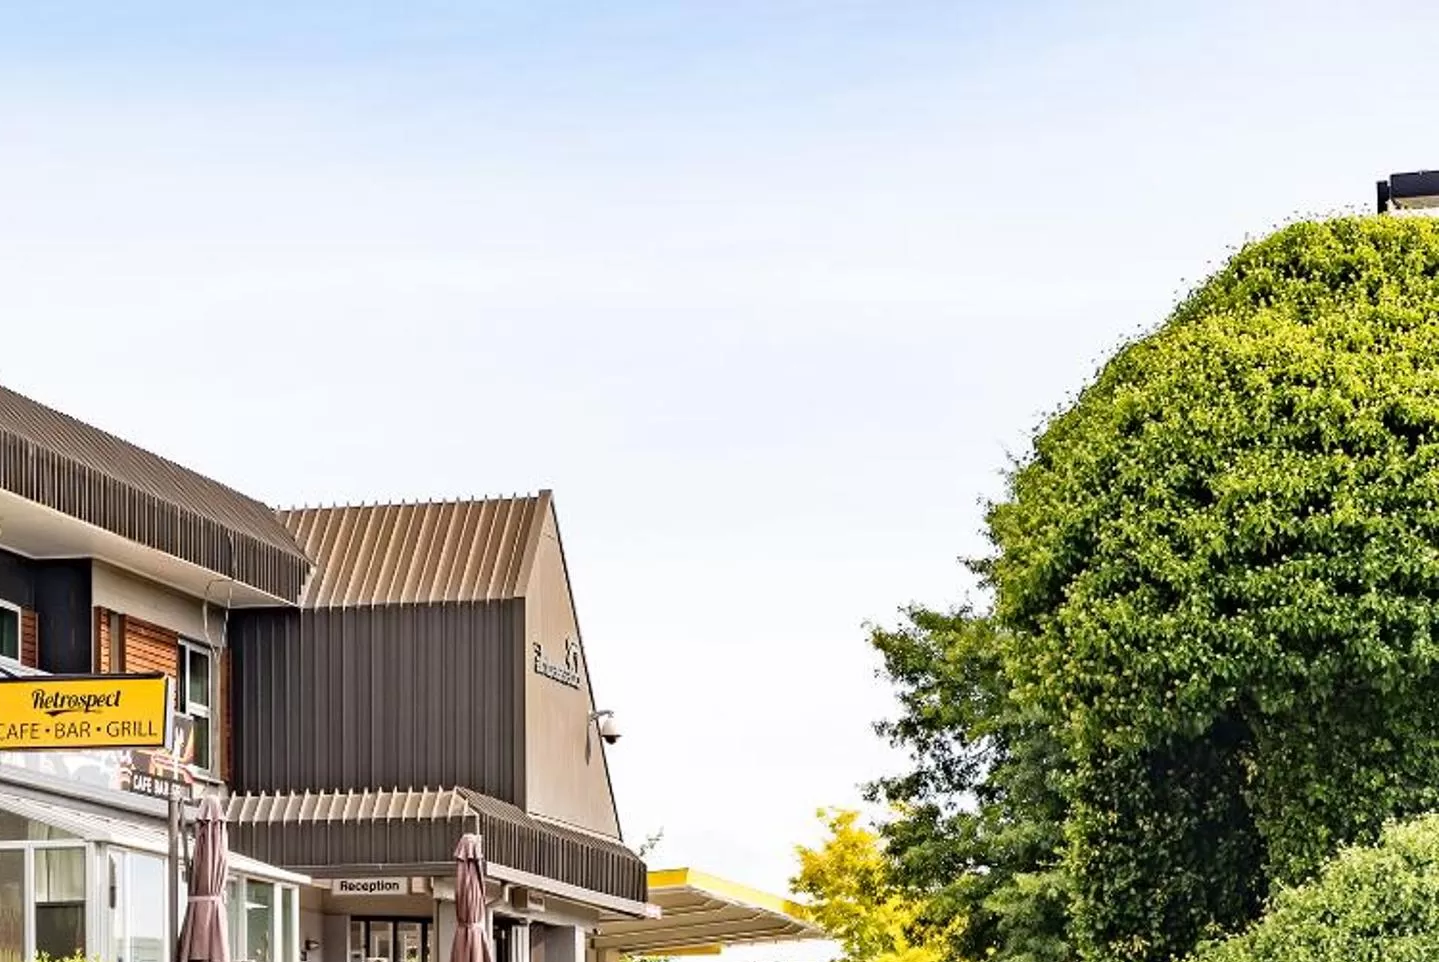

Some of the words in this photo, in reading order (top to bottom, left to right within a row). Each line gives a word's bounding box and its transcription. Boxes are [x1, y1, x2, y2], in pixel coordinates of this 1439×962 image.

[32, 688, 121, 713] Retrospect
[54, 721, 91, 739] BAR
[106, 720, 158, 738] GRILL
[133, 774, 152, 793] CAFE
[340, 880, 400, 893] Reception
